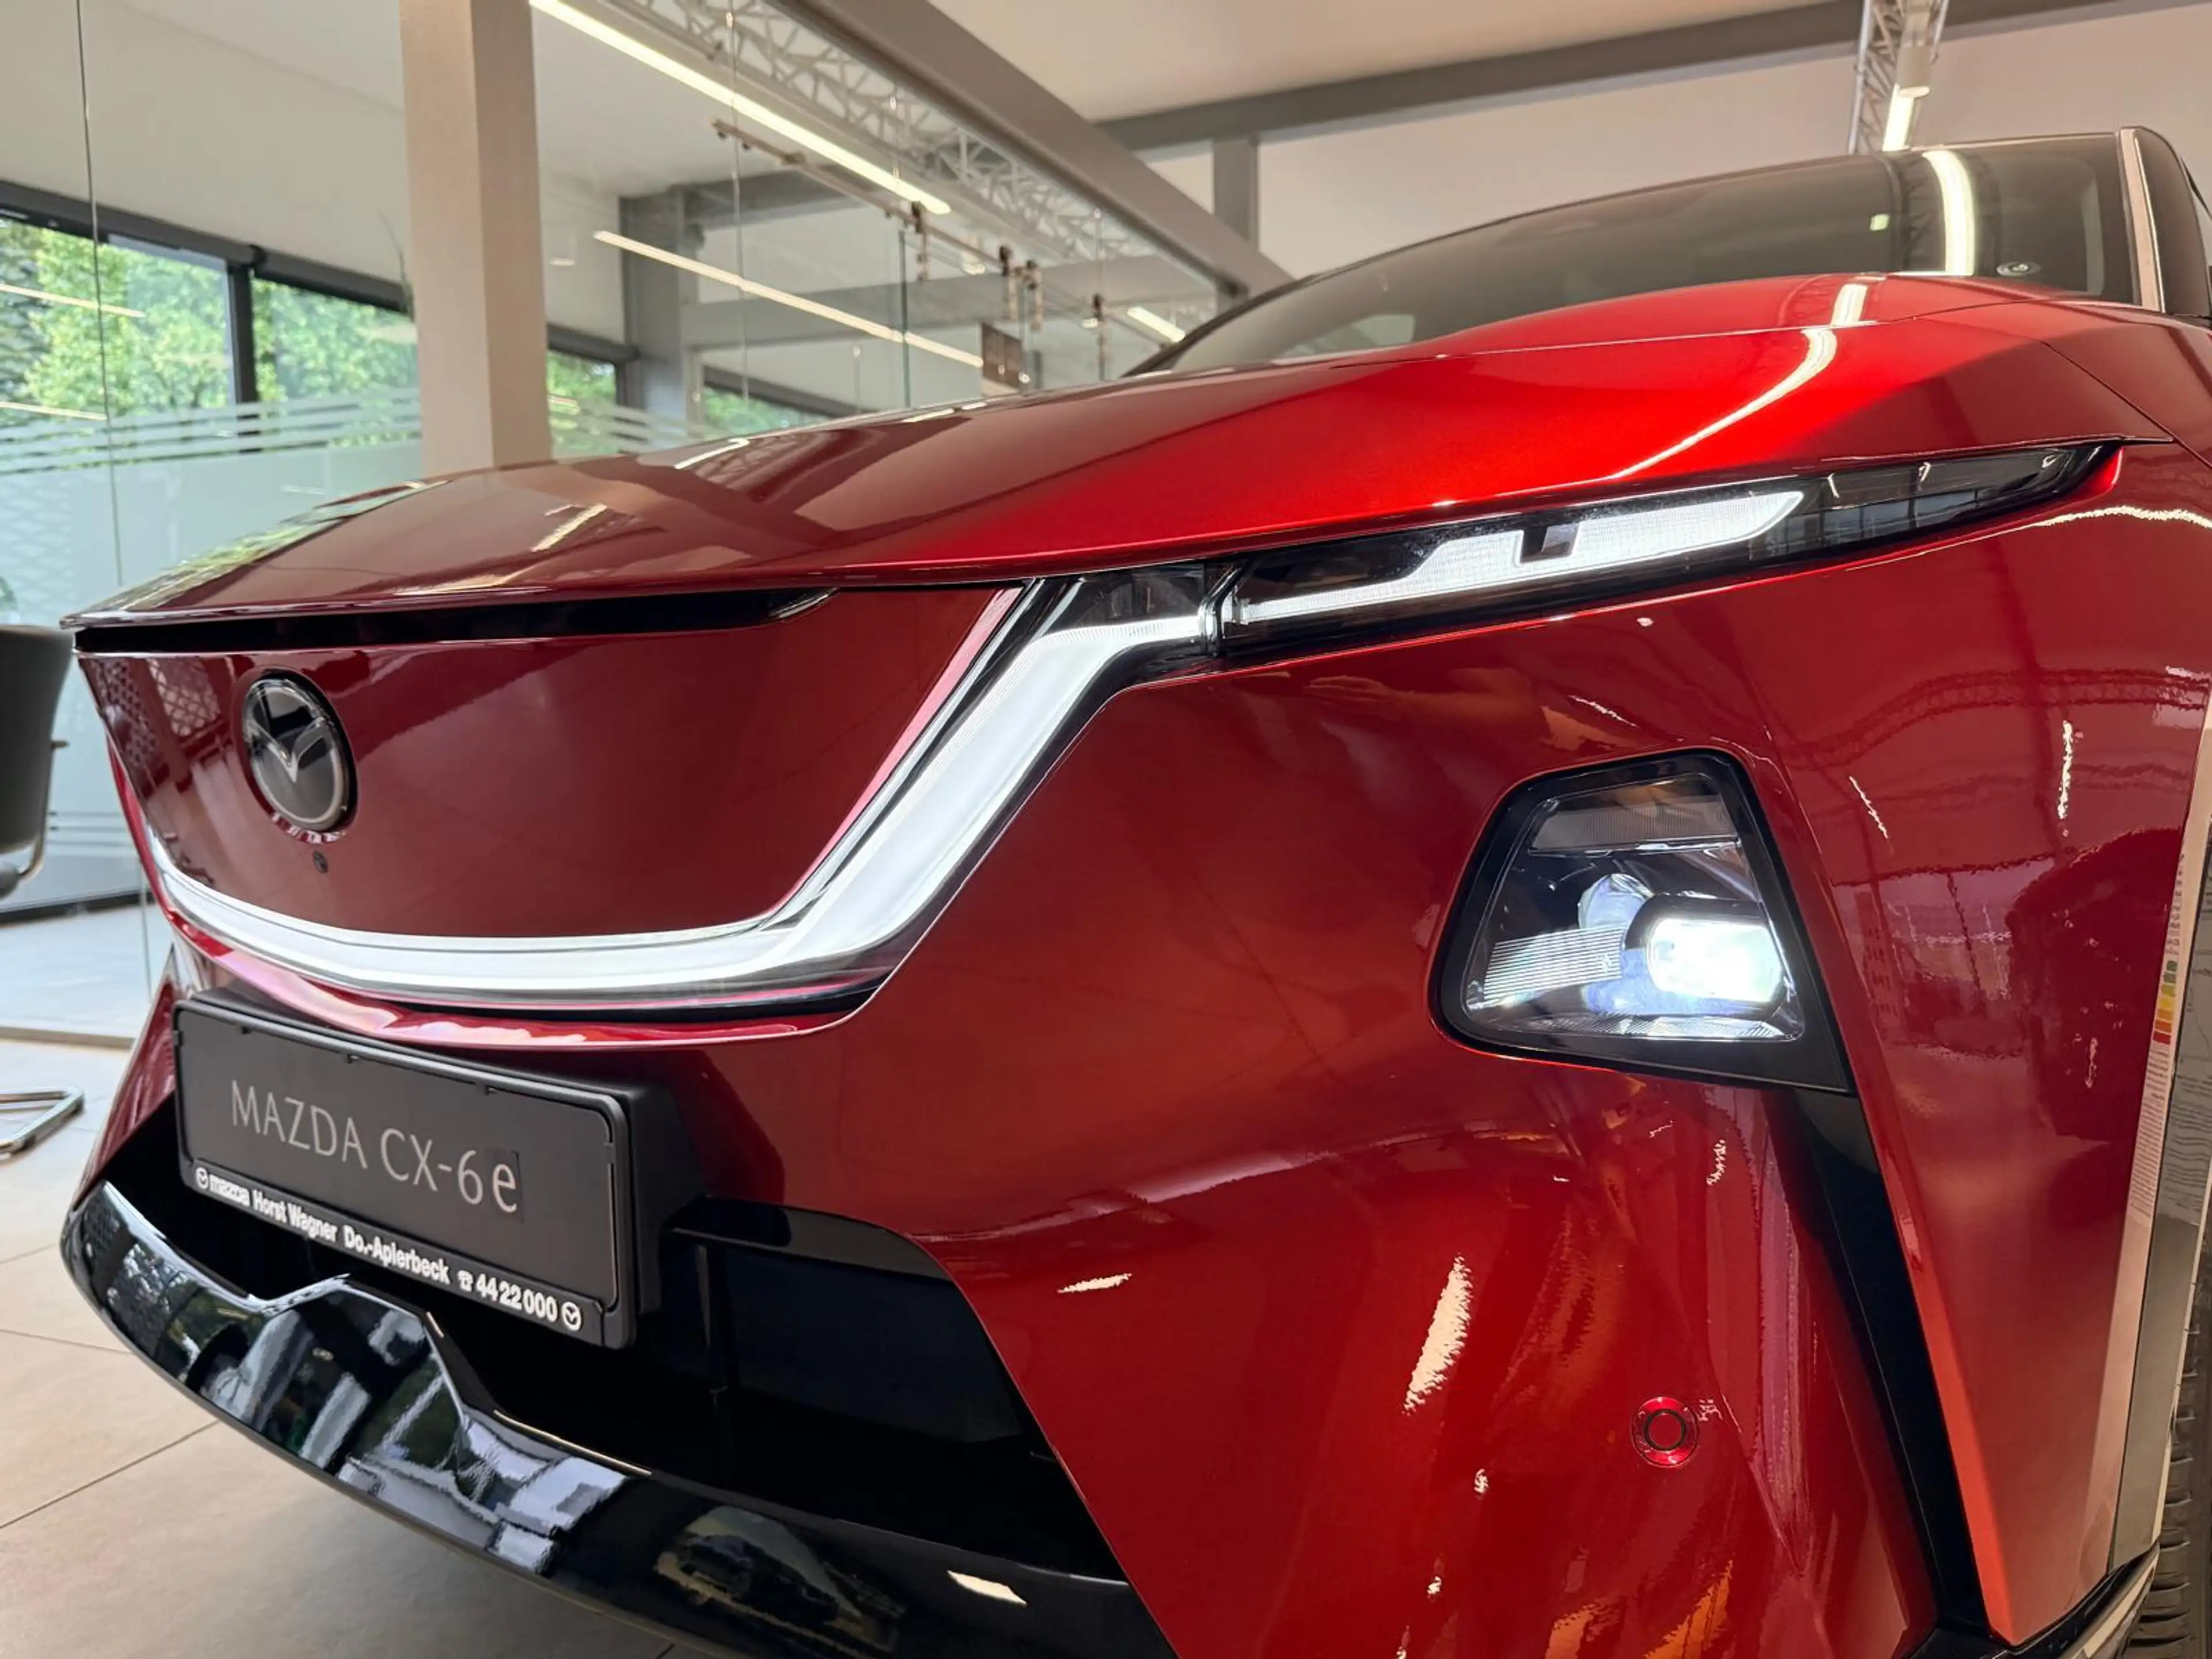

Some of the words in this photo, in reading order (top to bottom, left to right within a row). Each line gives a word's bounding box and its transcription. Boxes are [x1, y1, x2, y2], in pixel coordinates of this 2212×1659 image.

[232, 1080, 368, 1169] MAZDA
[380, 1128, 517, 1213] CX-6e
[252, 1189, 286, 1224] Horst
[287, 1202, 338, 1242] Wagner
[343, 1225, 450, 1285] Do.-Aplerbeck
